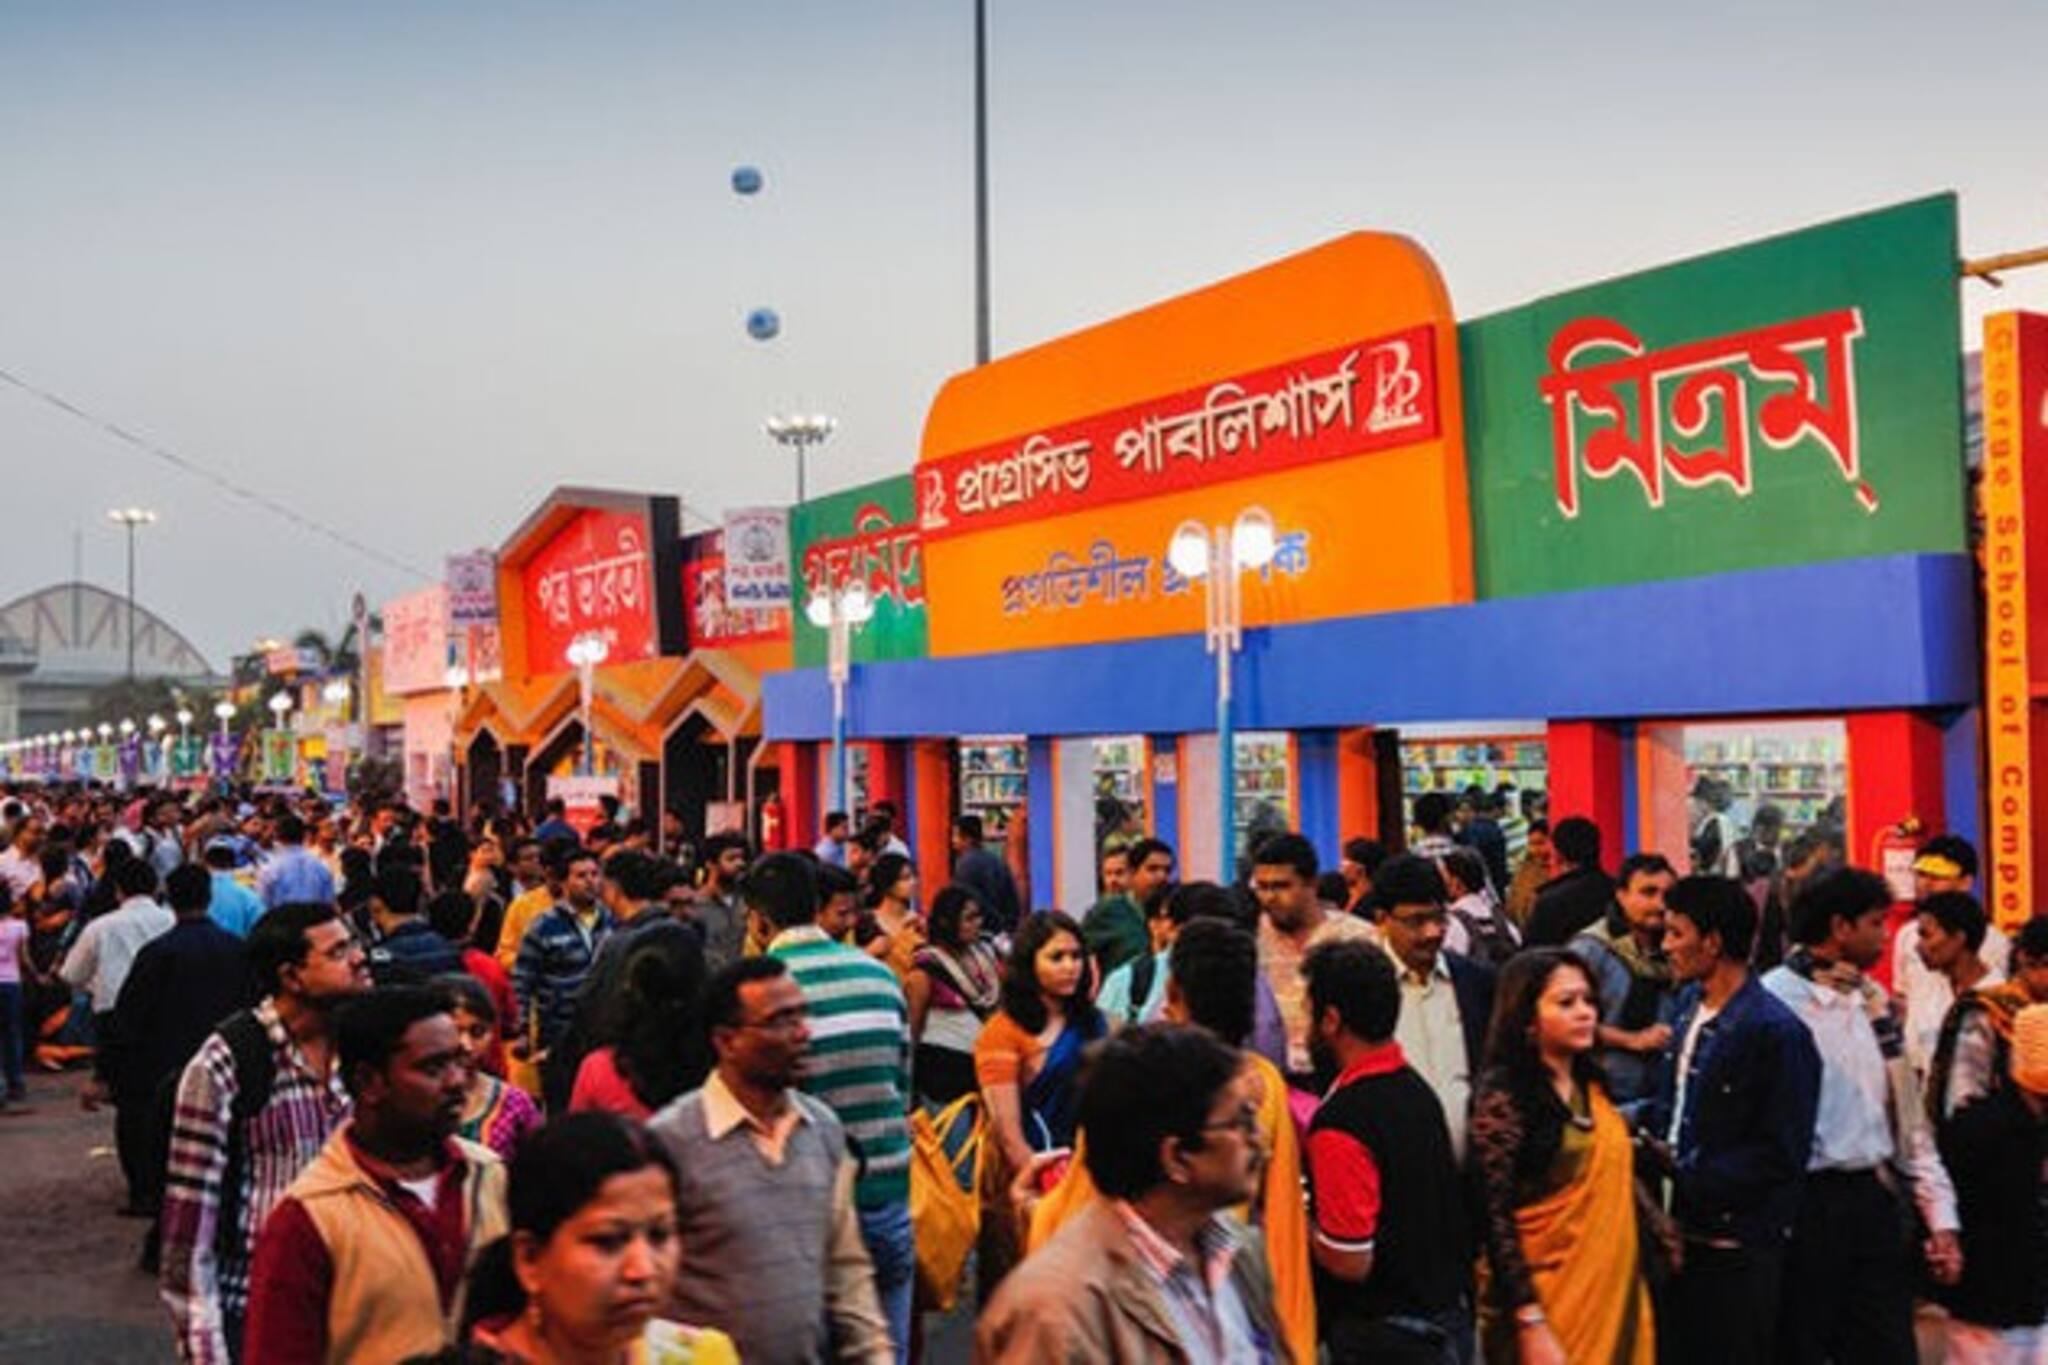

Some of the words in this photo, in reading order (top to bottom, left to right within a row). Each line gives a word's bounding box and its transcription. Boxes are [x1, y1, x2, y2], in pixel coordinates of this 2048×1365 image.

[956, 434, 1091, 513] প্রগ্রেসিভ
[1114, 350, 1360, 472] পাবলিশার্স
[1538, 307, 1879, 518] মিত্রম্
[1996, 514, 2020, 664] School
[2001, 695, 2022, 735] of
